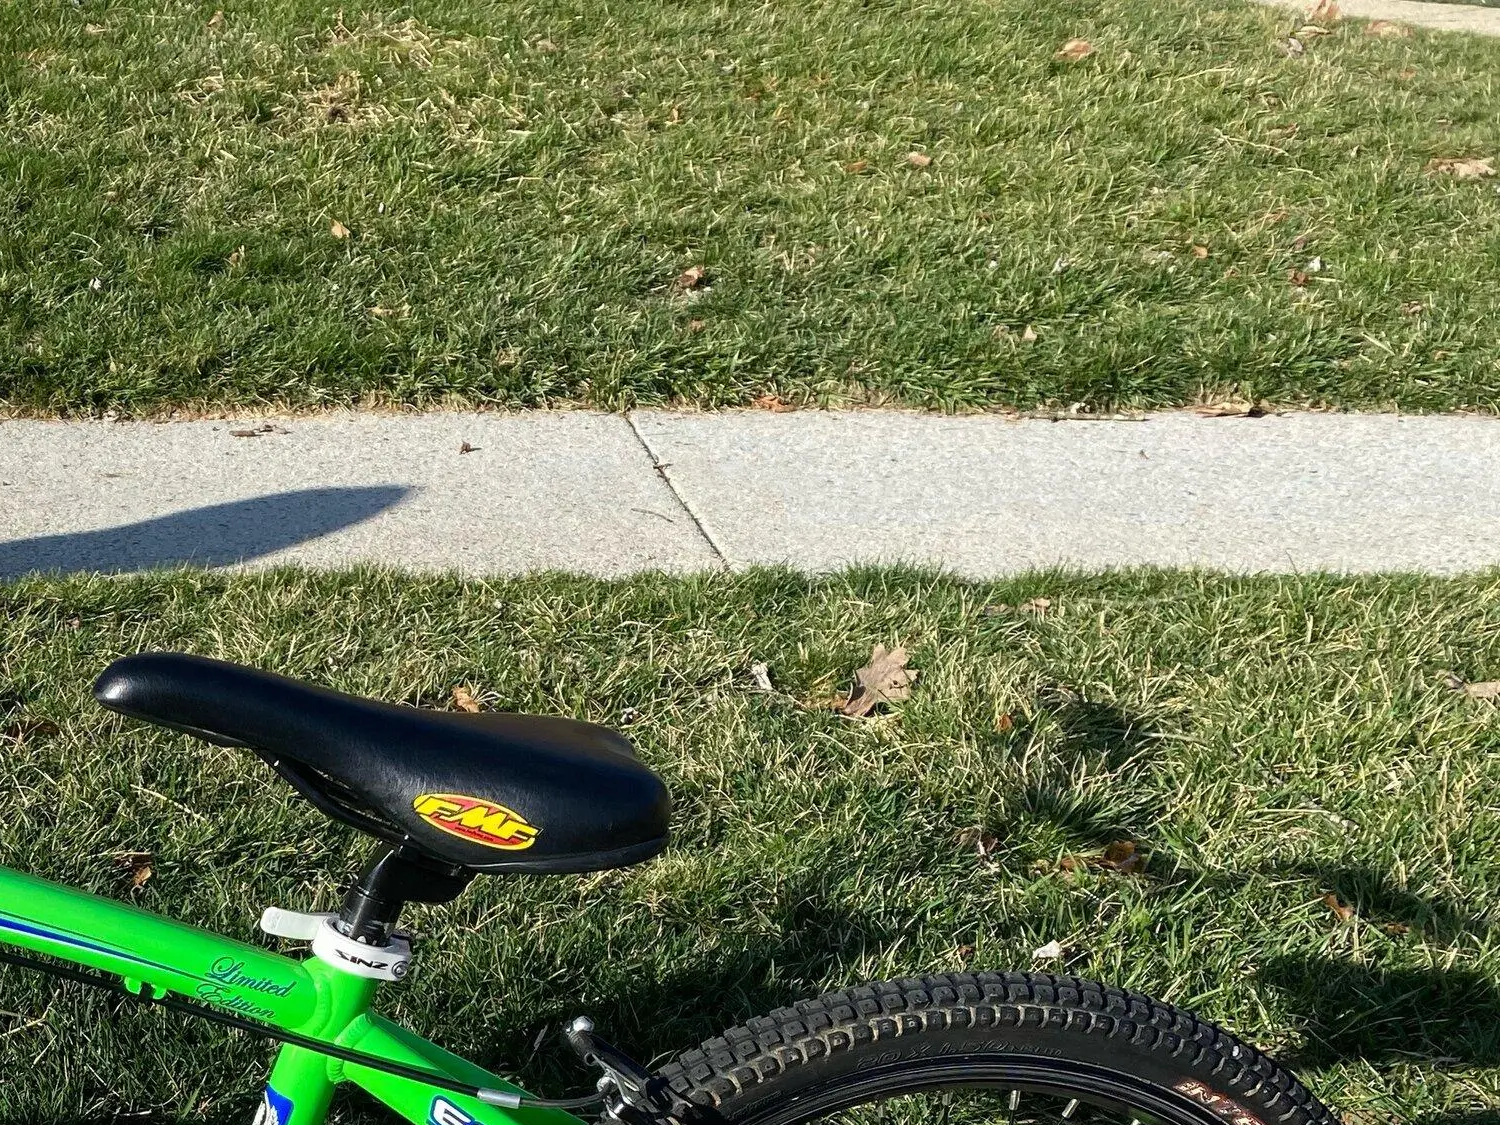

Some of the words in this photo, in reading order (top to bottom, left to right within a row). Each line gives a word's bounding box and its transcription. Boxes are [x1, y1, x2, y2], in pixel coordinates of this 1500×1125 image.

[414, 795, 543, 841] FMF
[204, 956, 297, 998] Limited
[196, 983, 276, 1019] Edition
